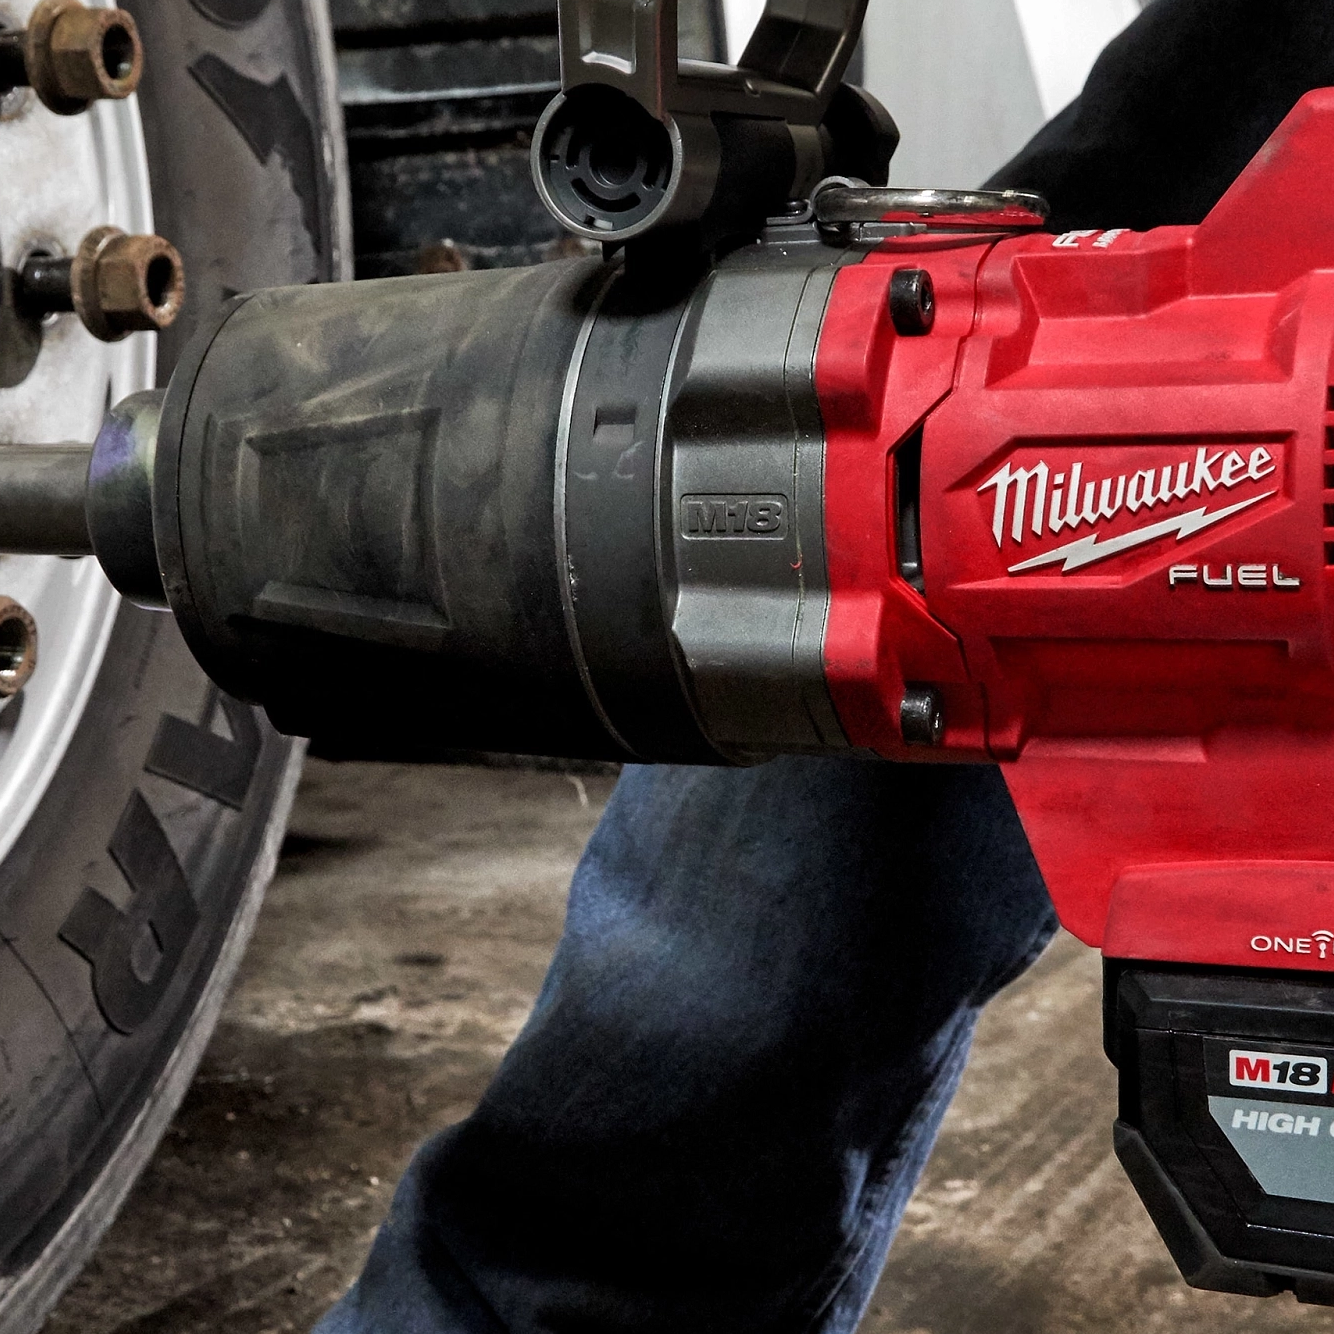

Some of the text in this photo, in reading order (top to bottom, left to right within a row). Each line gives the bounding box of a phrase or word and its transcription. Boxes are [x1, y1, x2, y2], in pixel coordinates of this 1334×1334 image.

[977, 446, 1276, 549] Milwaukee
[687, 499, 783, 534] M18
[1169, 564, 1300, 586] FUEL
[1234, 1056, 1322, 1087] M18
[1231, 1109, 1319, 1136] HIGH
